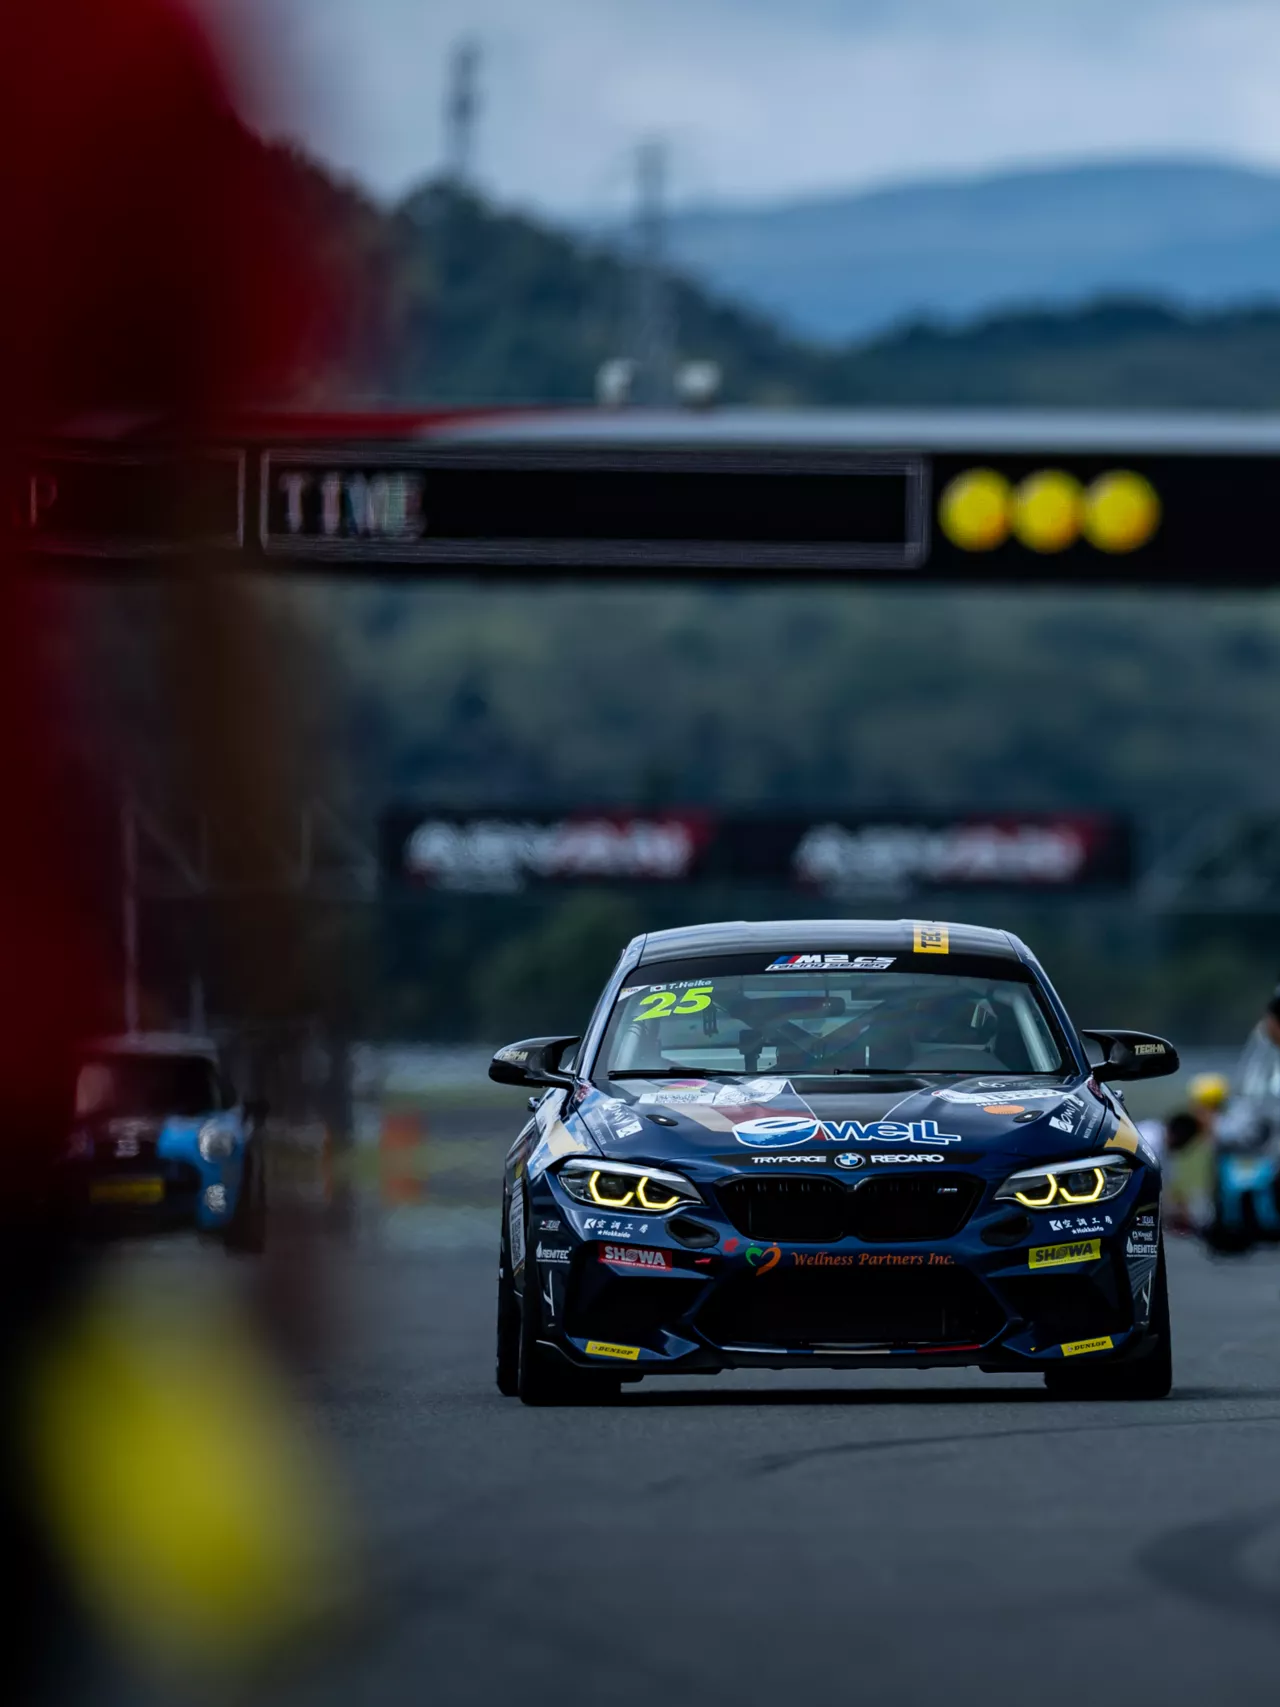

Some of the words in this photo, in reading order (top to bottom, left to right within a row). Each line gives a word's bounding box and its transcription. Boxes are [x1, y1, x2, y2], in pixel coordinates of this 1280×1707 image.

[633, 987, 713, 1021] 25
[1134, 1044, 1166, 1056] TECH-M
[751, 1155, 827, 1164] TRYFORCE
[870, 1154, 945, 1164] RECARO
[604, 1245, 666, 1266] SHOWA
[791, 1251, 853, 1266] Wellness
[858, 1252, 923, 1265] Partners
[928, 1253, 955, 1265] Inc.
[598, 1345, 634, 1356] DUNLOP
[1074, 1340, 1107, 1351] DUNLOP
